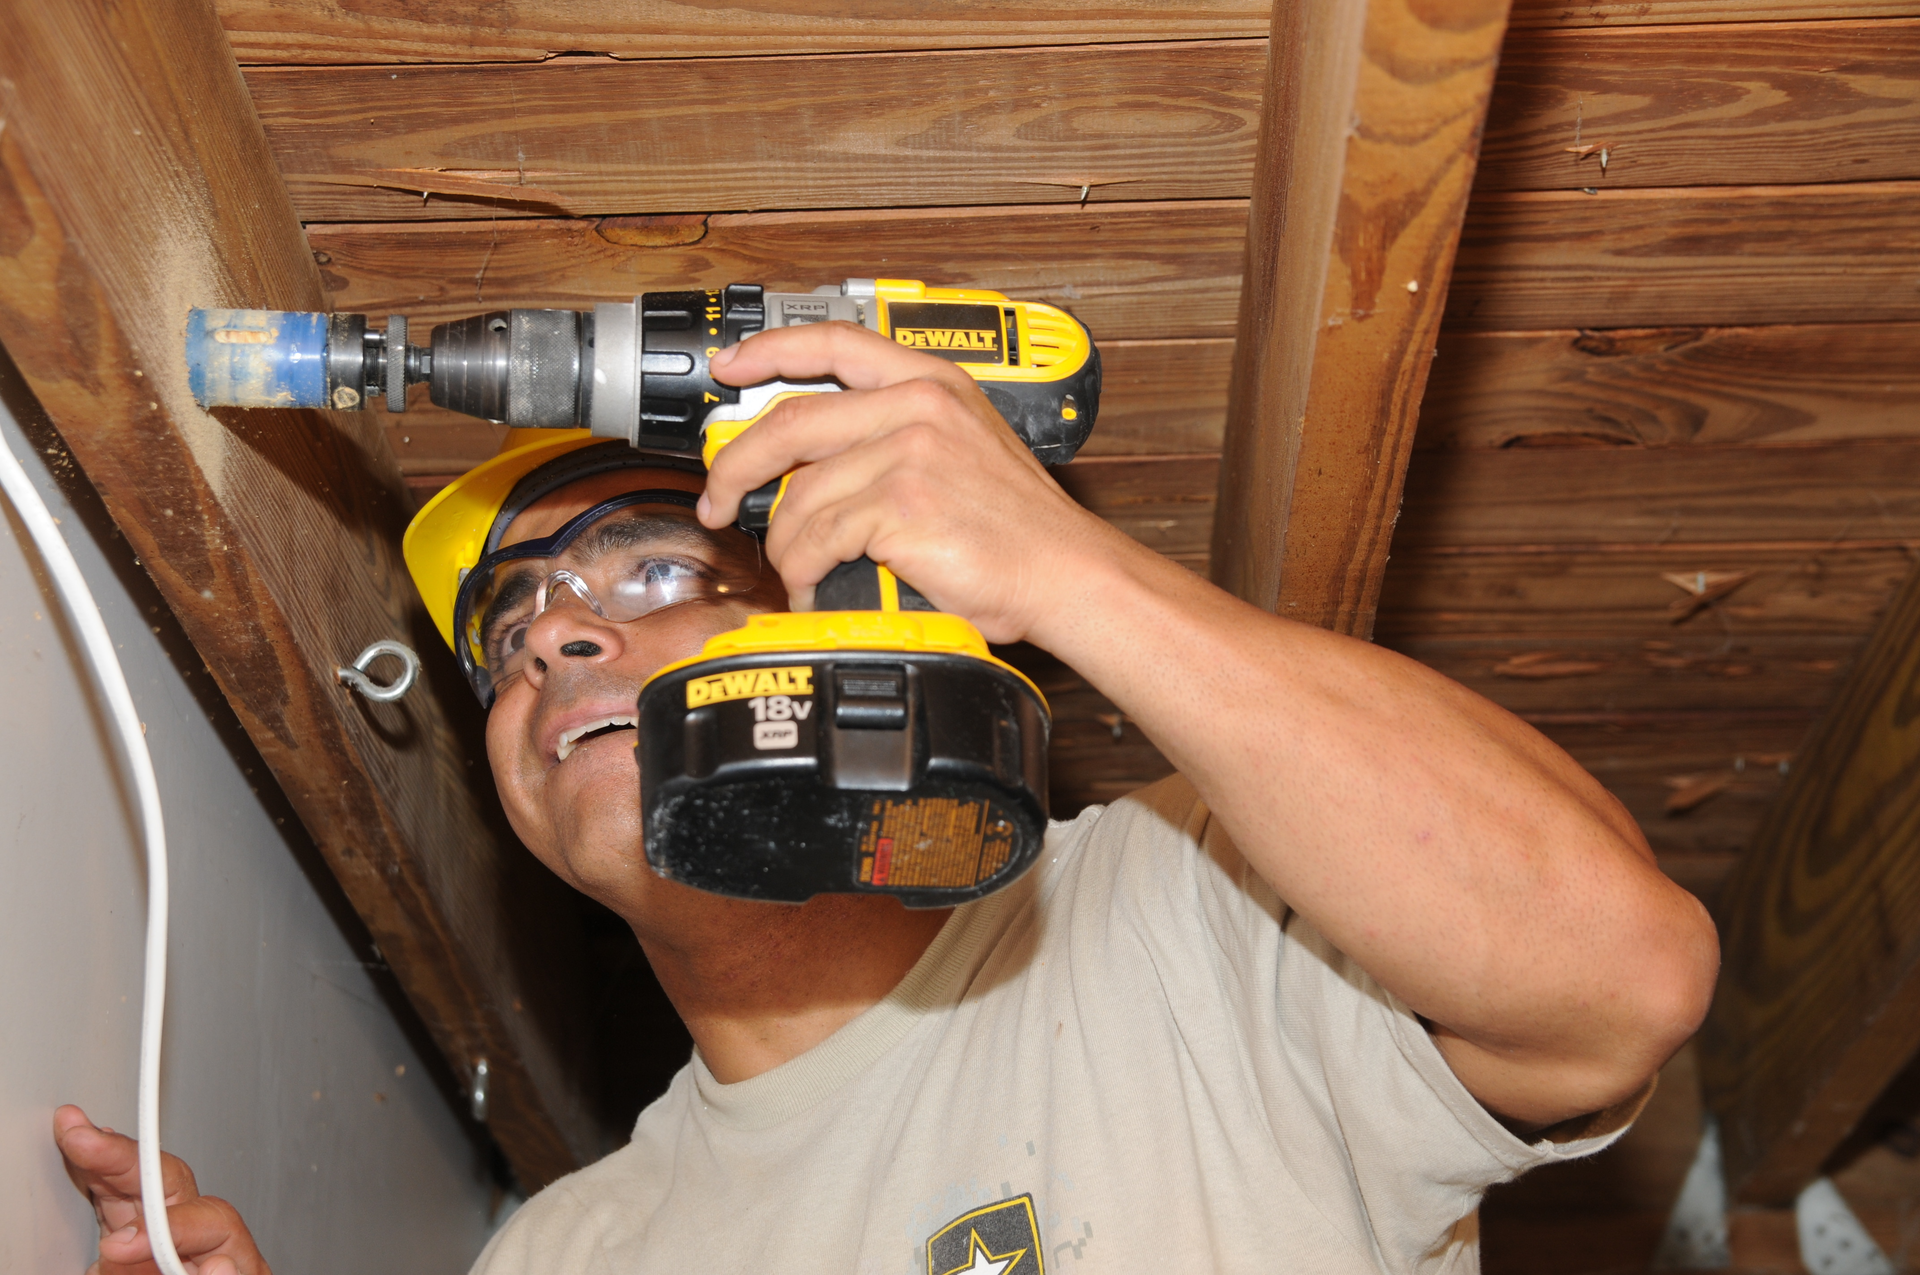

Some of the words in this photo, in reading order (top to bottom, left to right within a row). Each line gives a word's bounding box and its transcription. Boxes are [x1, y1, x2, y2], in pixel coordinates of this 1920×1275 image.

[705, 306, 721, 321] 11
[786, 303, 825, 311] XRP
[895, 328, 997, 349] DEWALT
[704, 391, 720, 403] 7
[686, 668, 813, 706] DEWALT
